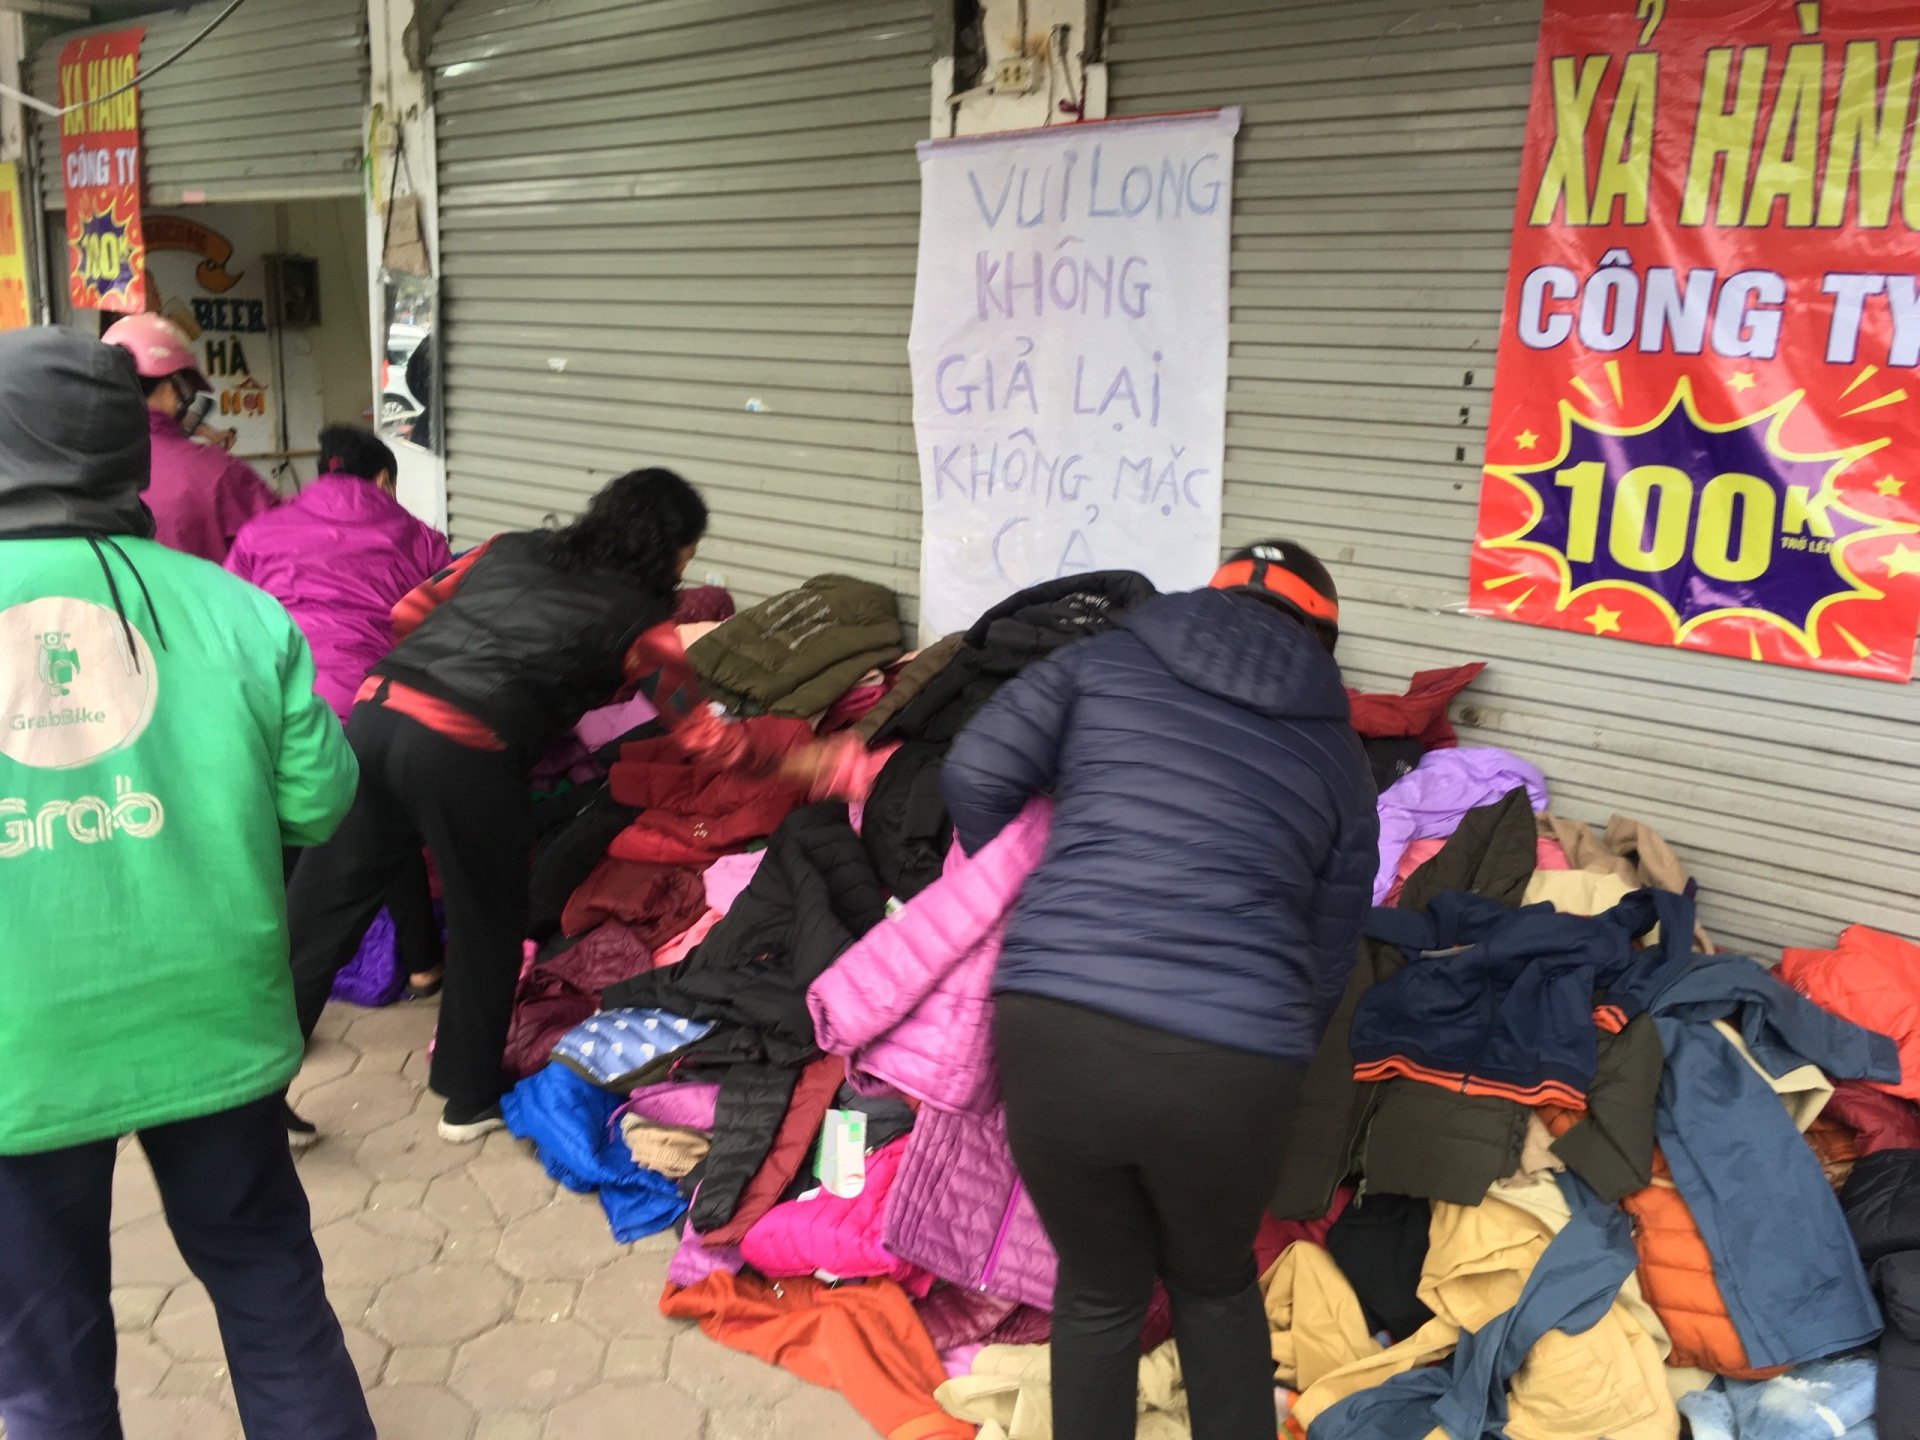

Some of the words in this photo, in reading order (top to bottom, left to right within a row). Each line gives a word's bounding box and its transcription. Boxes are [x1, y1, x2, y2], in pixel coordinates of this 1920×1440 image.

[1528, 0, 1667, 227] XẢ
[1678, 1, 1920, 232] HÀN
[115, 146, 137, 186] TY
[191, 297, 266, 333] BEER
[975, 235, 1152, 321] KHÔNG
[1517, 247, 1787, 360] CÔNG
[206, 335, 251, 377] HÀ
[935, 335, 1040, 416] GIẢ
[932, 427, 1092, 508] KHÔNG
[9, 707, 106, 731] GrabBike
[0, 774, 164, 858] Grab
